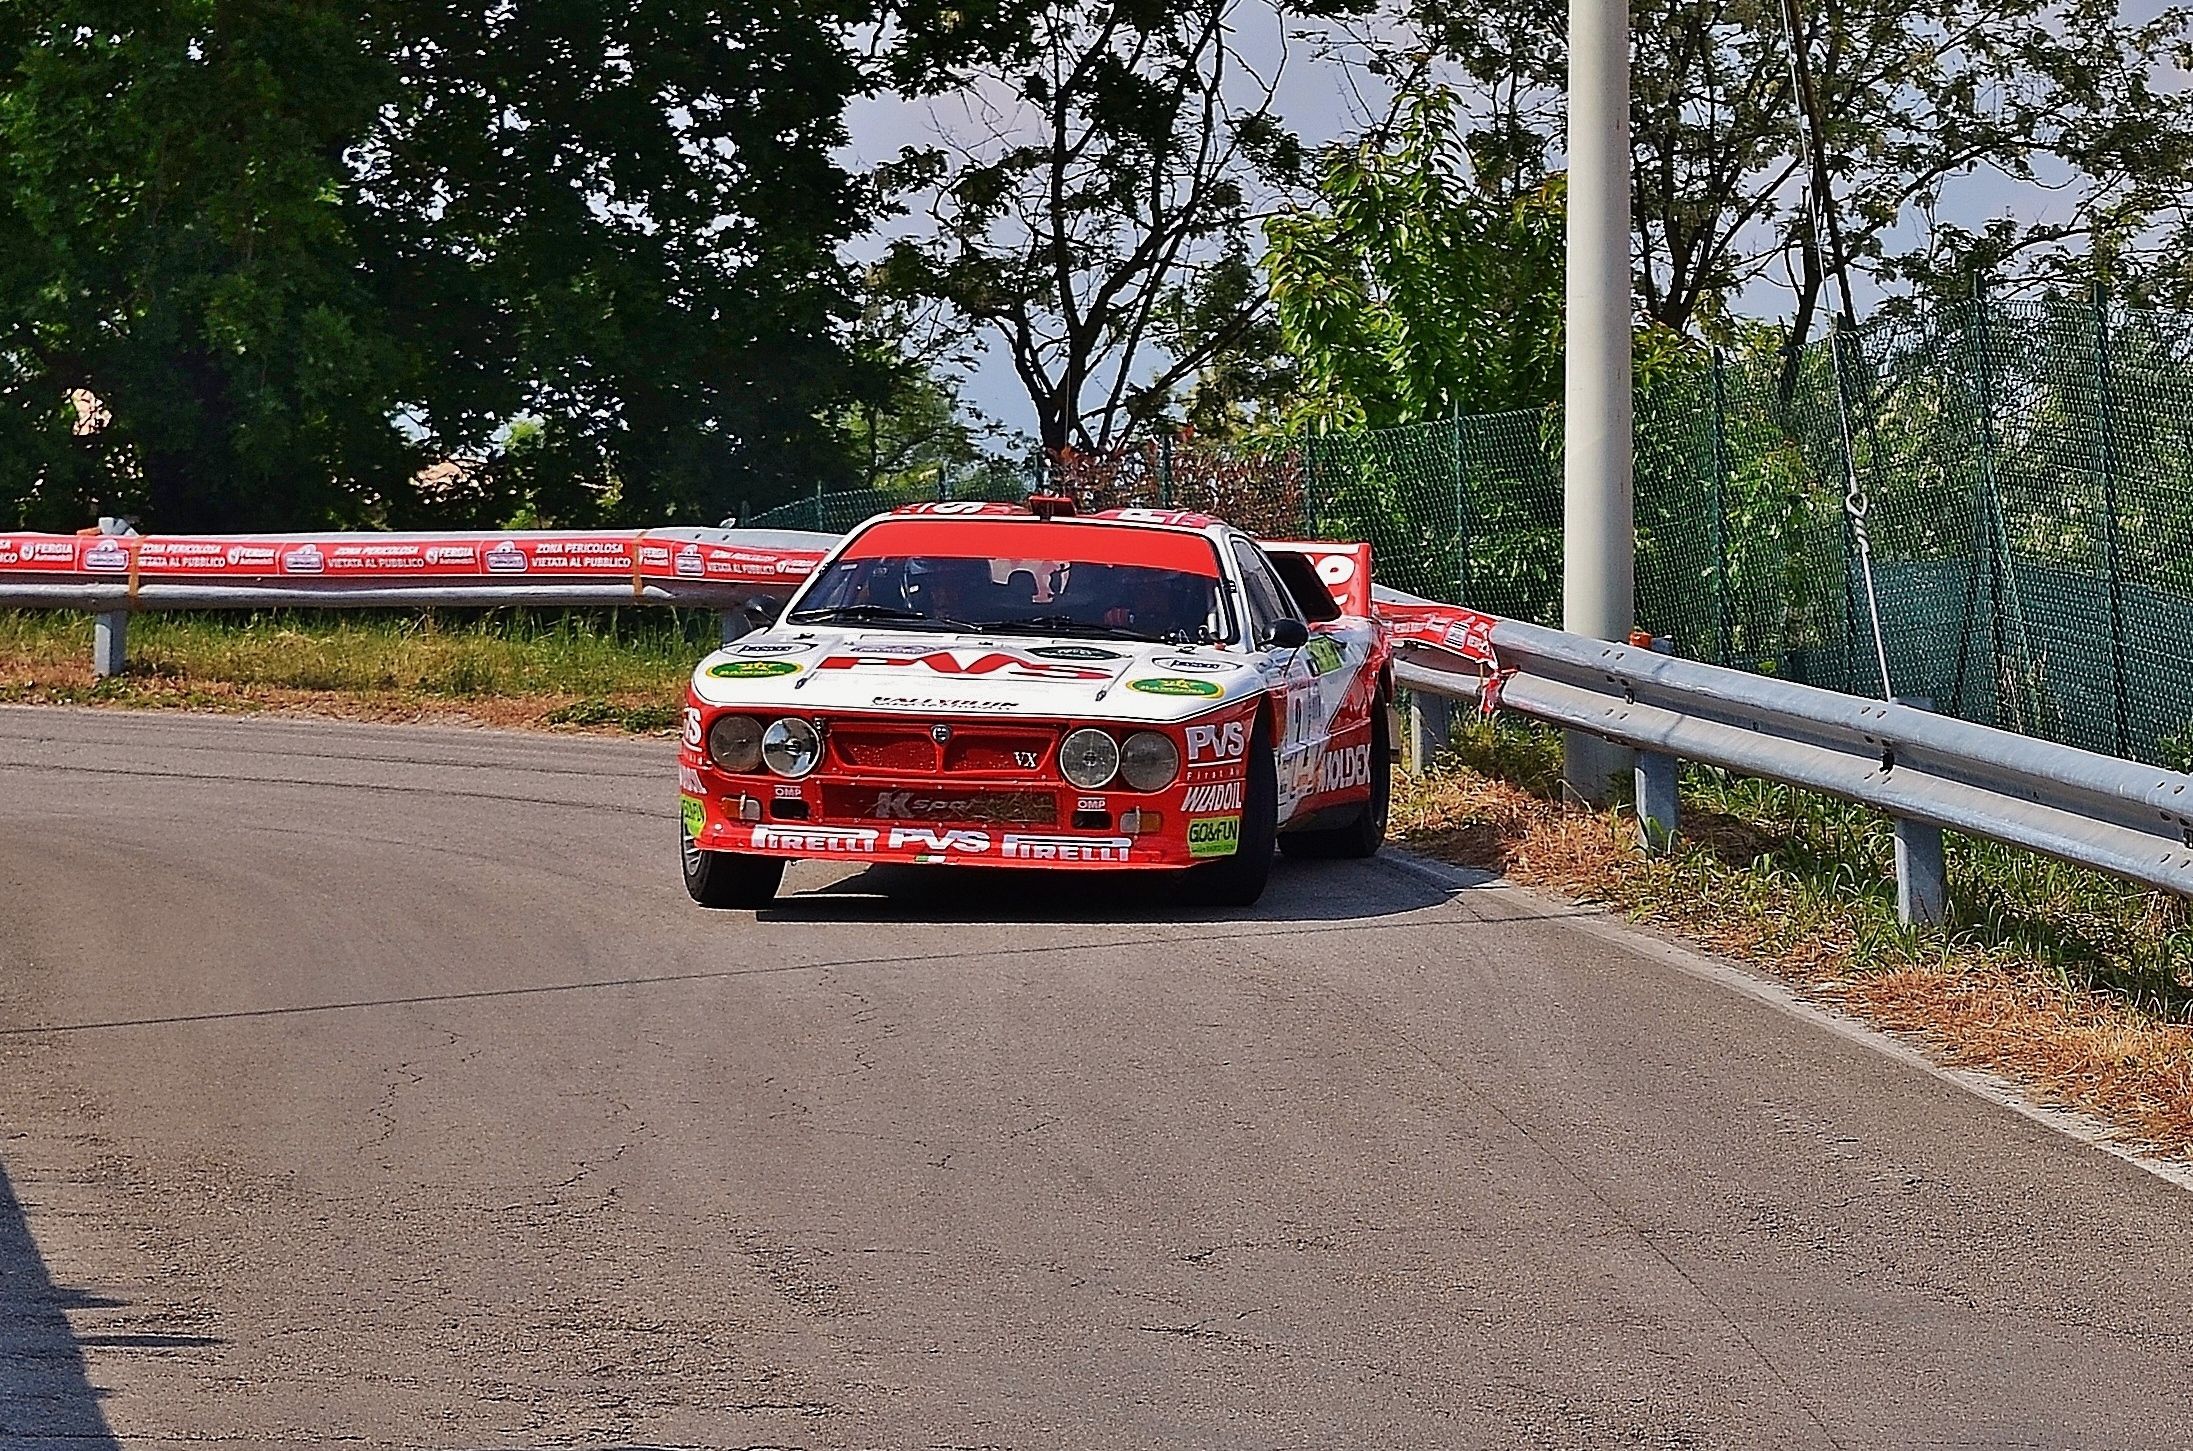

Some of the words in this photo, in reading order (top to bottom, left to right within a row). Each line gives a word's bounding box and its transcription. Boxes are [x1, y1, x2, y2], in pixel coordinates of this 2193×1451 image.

[536, 543, 562, 554] ZONA
[565, 543, 624, 554] PERICOLOSA
[169, 557, 181, 568] AL
[182, 557, 226, 568] PUBBLICO
[328, 558, 364, 568] VIETATA
[365, 558, 377, 568] AL
[379, 558, 424, 568] PUBBLICO
[532, 557, 568, 568] VIETATA
[569, 557, 582, 568] AL
[584, 557, 631, 568] PUBBLICO
[1185, 721, 1245, 761] PVS
[1013, 751, 1038, 768] VX
[775, 787, 802, 798] OMP
[1077, 799, 1106, 809] OMP
[1188, 820, 1238, 843] GO&FUN
[751, 824, 880, 853] PIRELLI
[888, 827, 991, 853] PVS
[1001, 834, 1133, 862] PIRELLI
